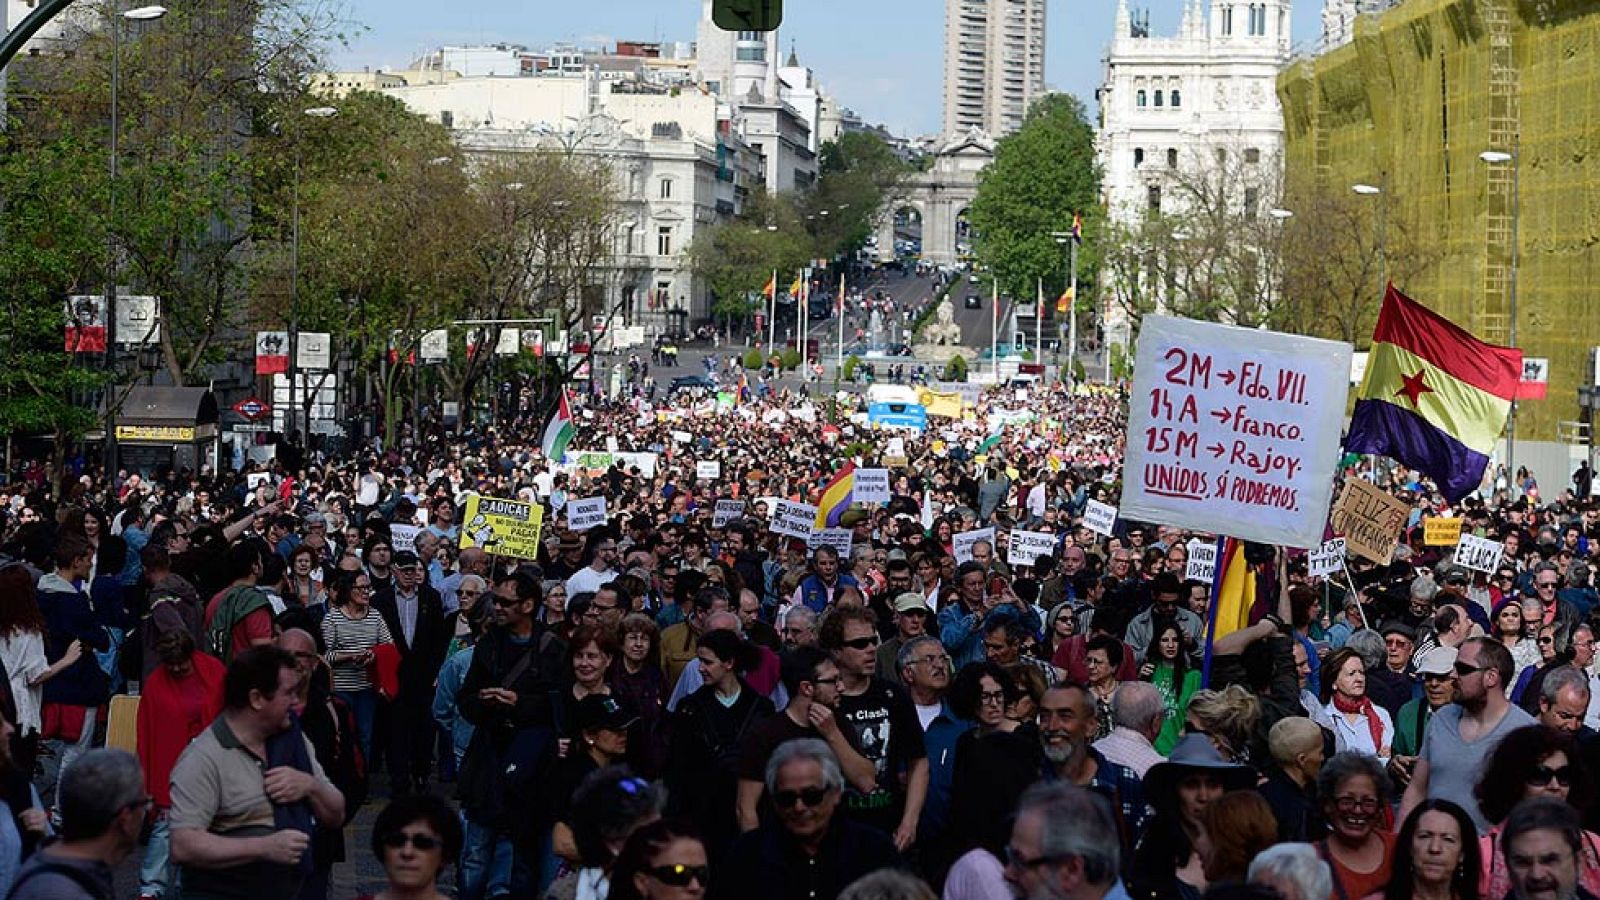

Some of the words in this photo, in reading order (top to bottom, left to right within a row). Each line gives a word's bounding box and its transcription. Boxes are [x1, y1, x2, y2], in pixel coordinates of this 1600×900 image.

[1165, 347, 1212, 389] 2M
[1237, 361, 1273, 401] Fdo.
[1277, 368, 1309, 406] VII.
[1232, 405, 1305, 442] Franco.
[1230, 440, 1302, 480] Rajoy.
[489, 500, 530, 517] ADICAE
[1230, 476, 1299, 512] PODREMOS.
[1343, 483, 1391, 523] FELIZ
[856, 707, 889, 720] Clash
